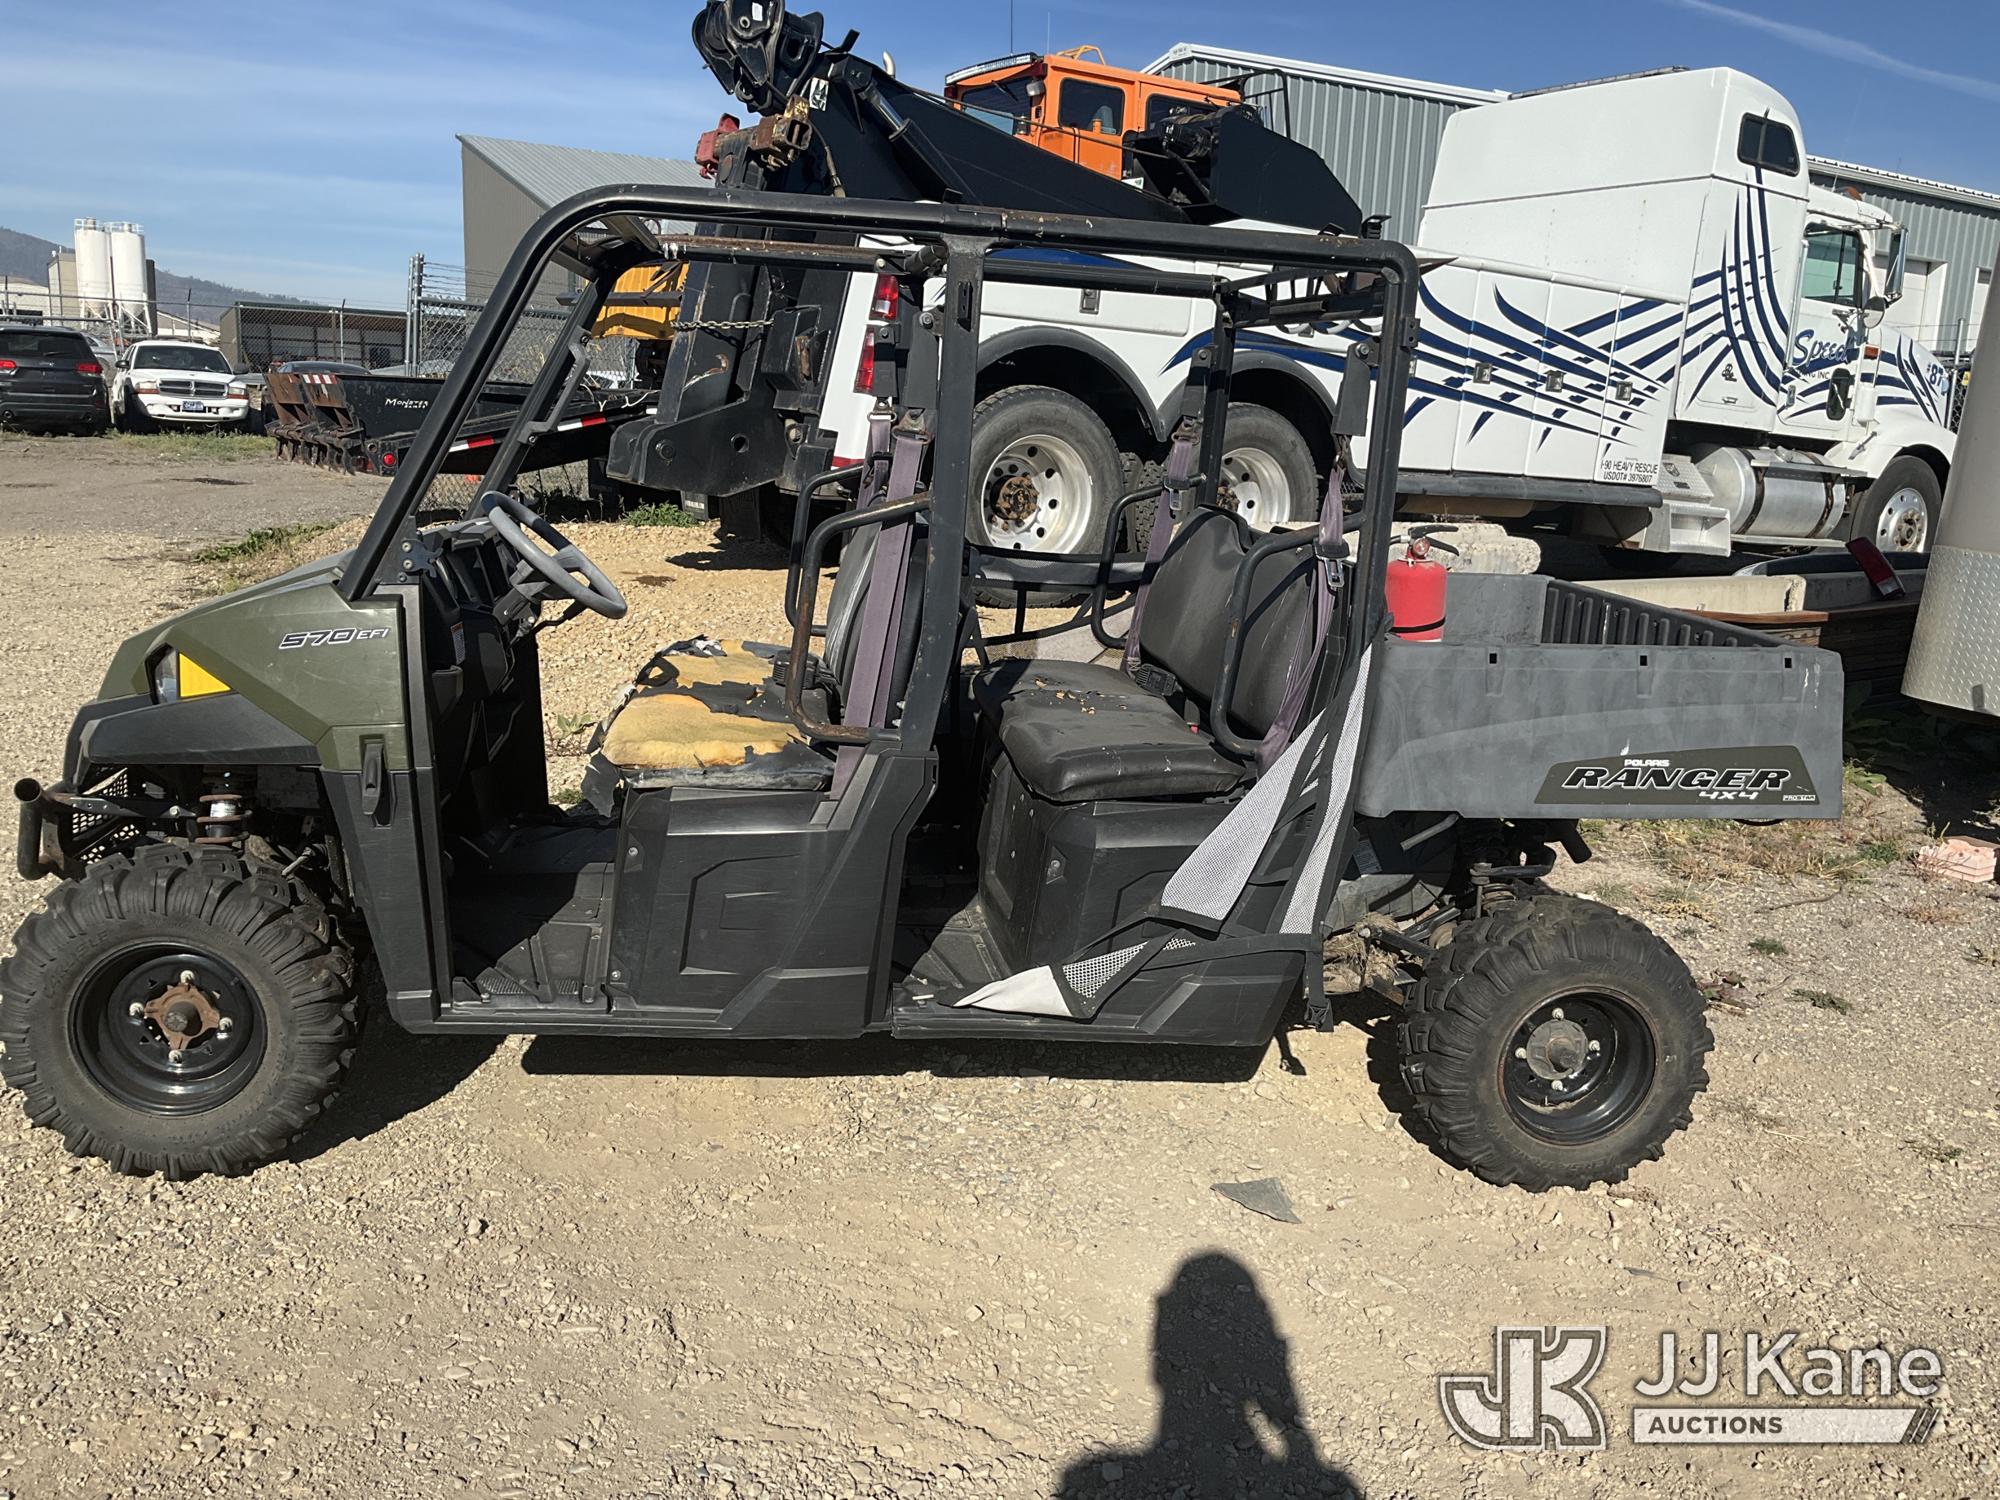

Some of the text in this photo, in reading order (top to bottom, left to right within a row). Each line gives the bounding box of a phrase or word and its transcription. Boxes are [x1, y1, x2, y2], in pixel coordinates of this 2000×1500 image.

[1613, 461, 1634, 471] HEAVY
[1635, 463, 1658, 474] RESCUE
[1603, 472, 1627, 480] USDOT#
[279, 628, 390, 650] 570 EFI
[1624, 759, 1670, 767] POLARIS
[1561, 766, 1791, 791] RANGER
